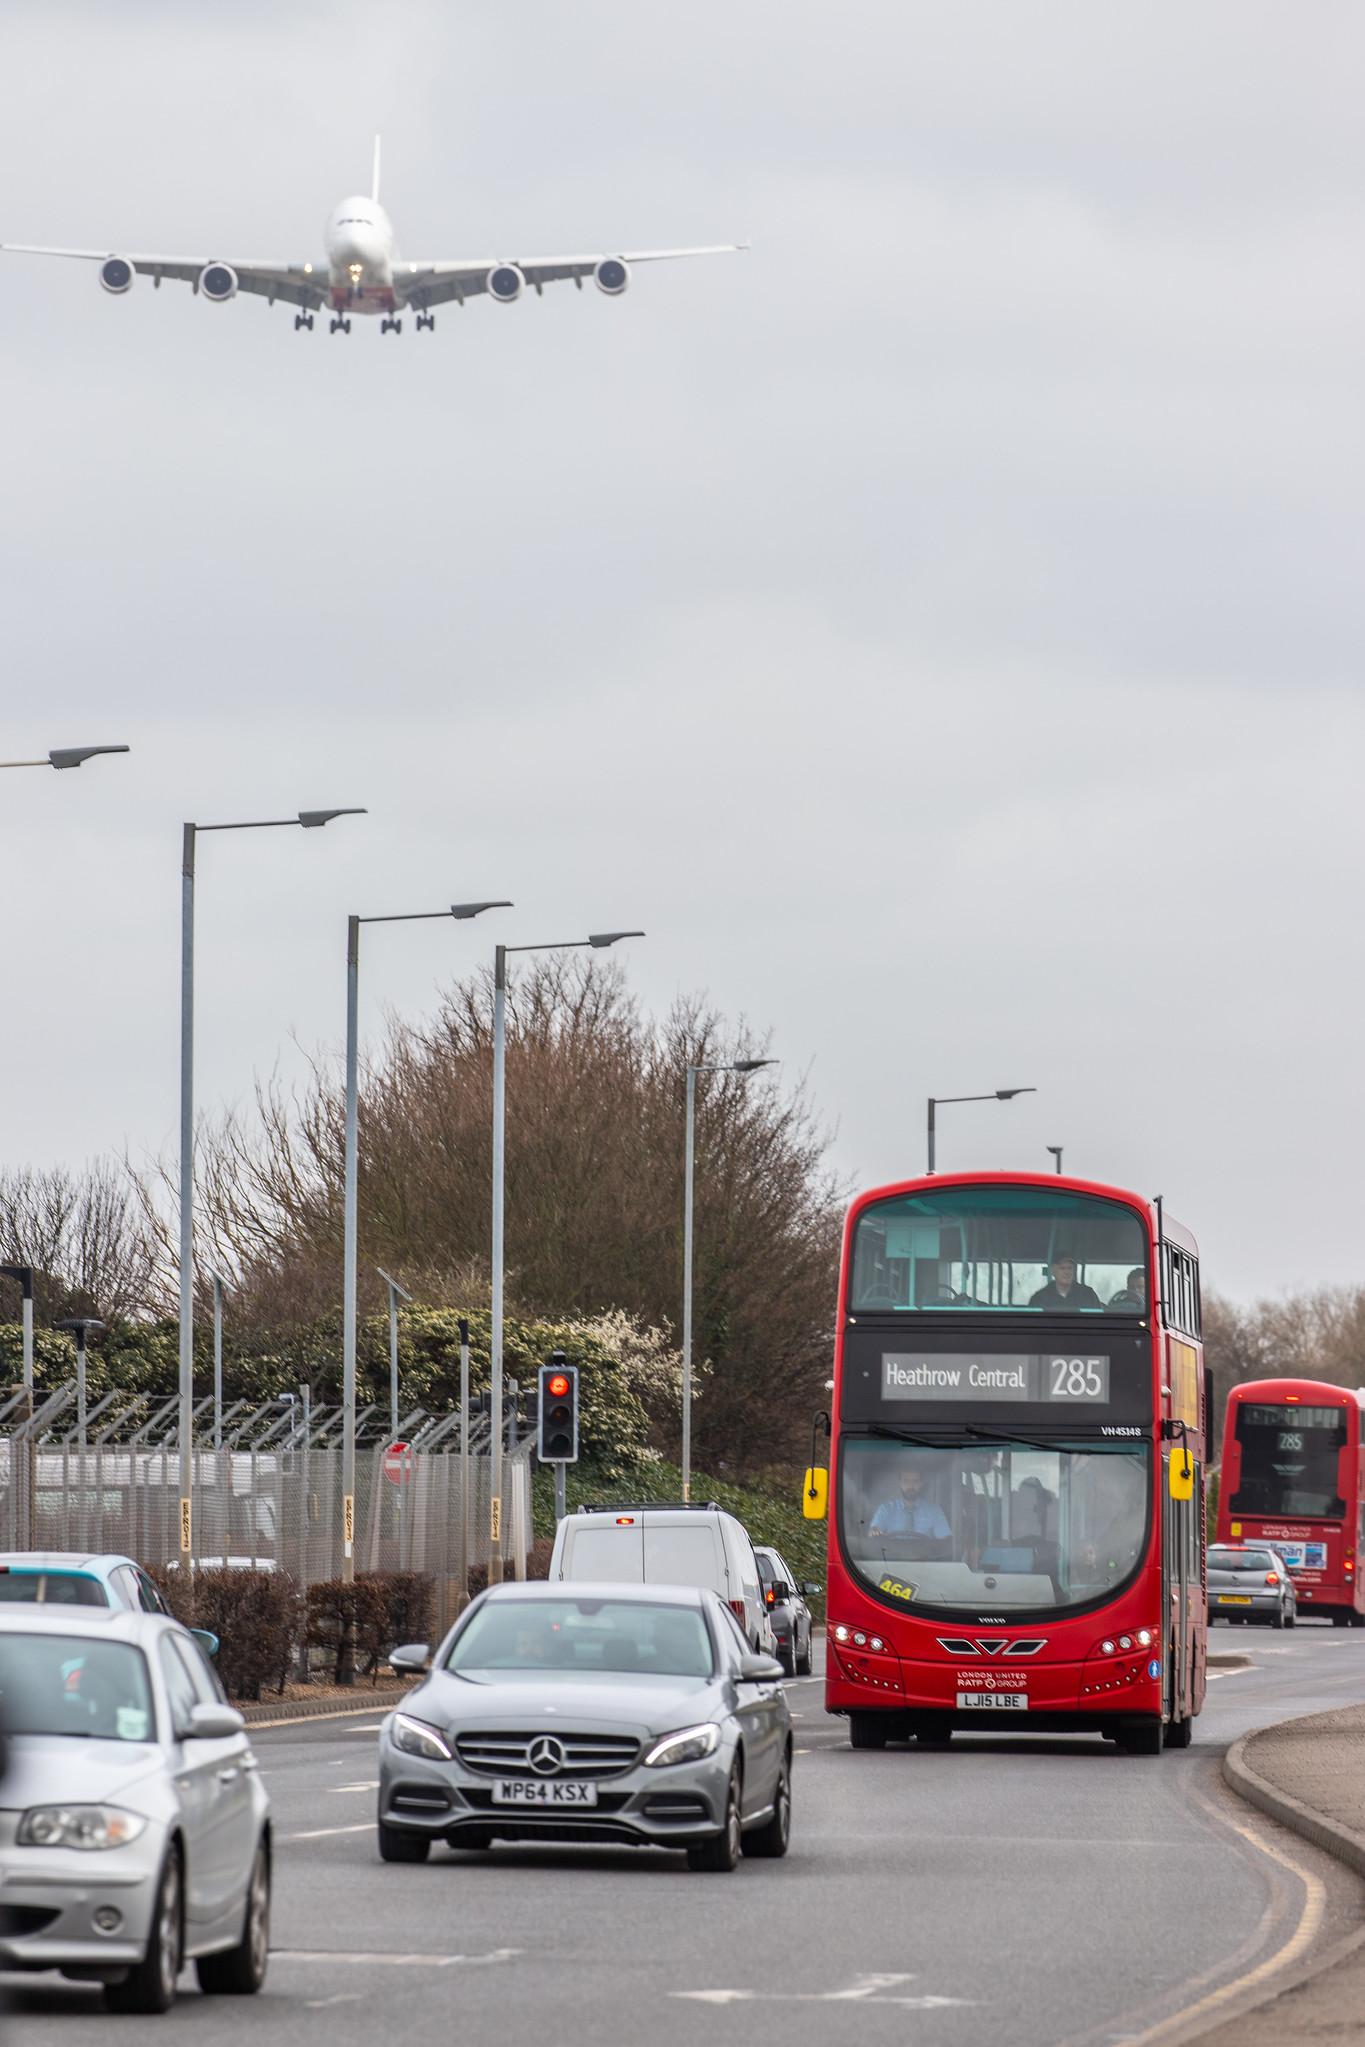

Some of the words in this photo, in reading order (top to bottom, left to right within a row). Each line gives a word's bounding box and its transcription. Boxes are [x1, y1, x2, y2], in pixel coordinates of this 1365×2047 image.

[886, 1363, 961, 1387] Heathrow
[968, 1364, 1026, 1389] Central
[1050, 1358, 1102, 1396] 285
[1279, 1432, 1303, 1451] 285
[880, 1580, 913, 1601] 464
[957, 1670, 993, 1679] LONDON
[995, 1671, 1028, 1680] UNITED
[957, 1679, 984, 1687] RATP
[996, 1680, 1028, 1688] GROUP
[964, 1694, 993, 1707] LJ15
[995, 1695, 1021, 1708] LBE
[501, 1781, 548, 1800] WP64
[553, 1783, 589, 1802] KSX
